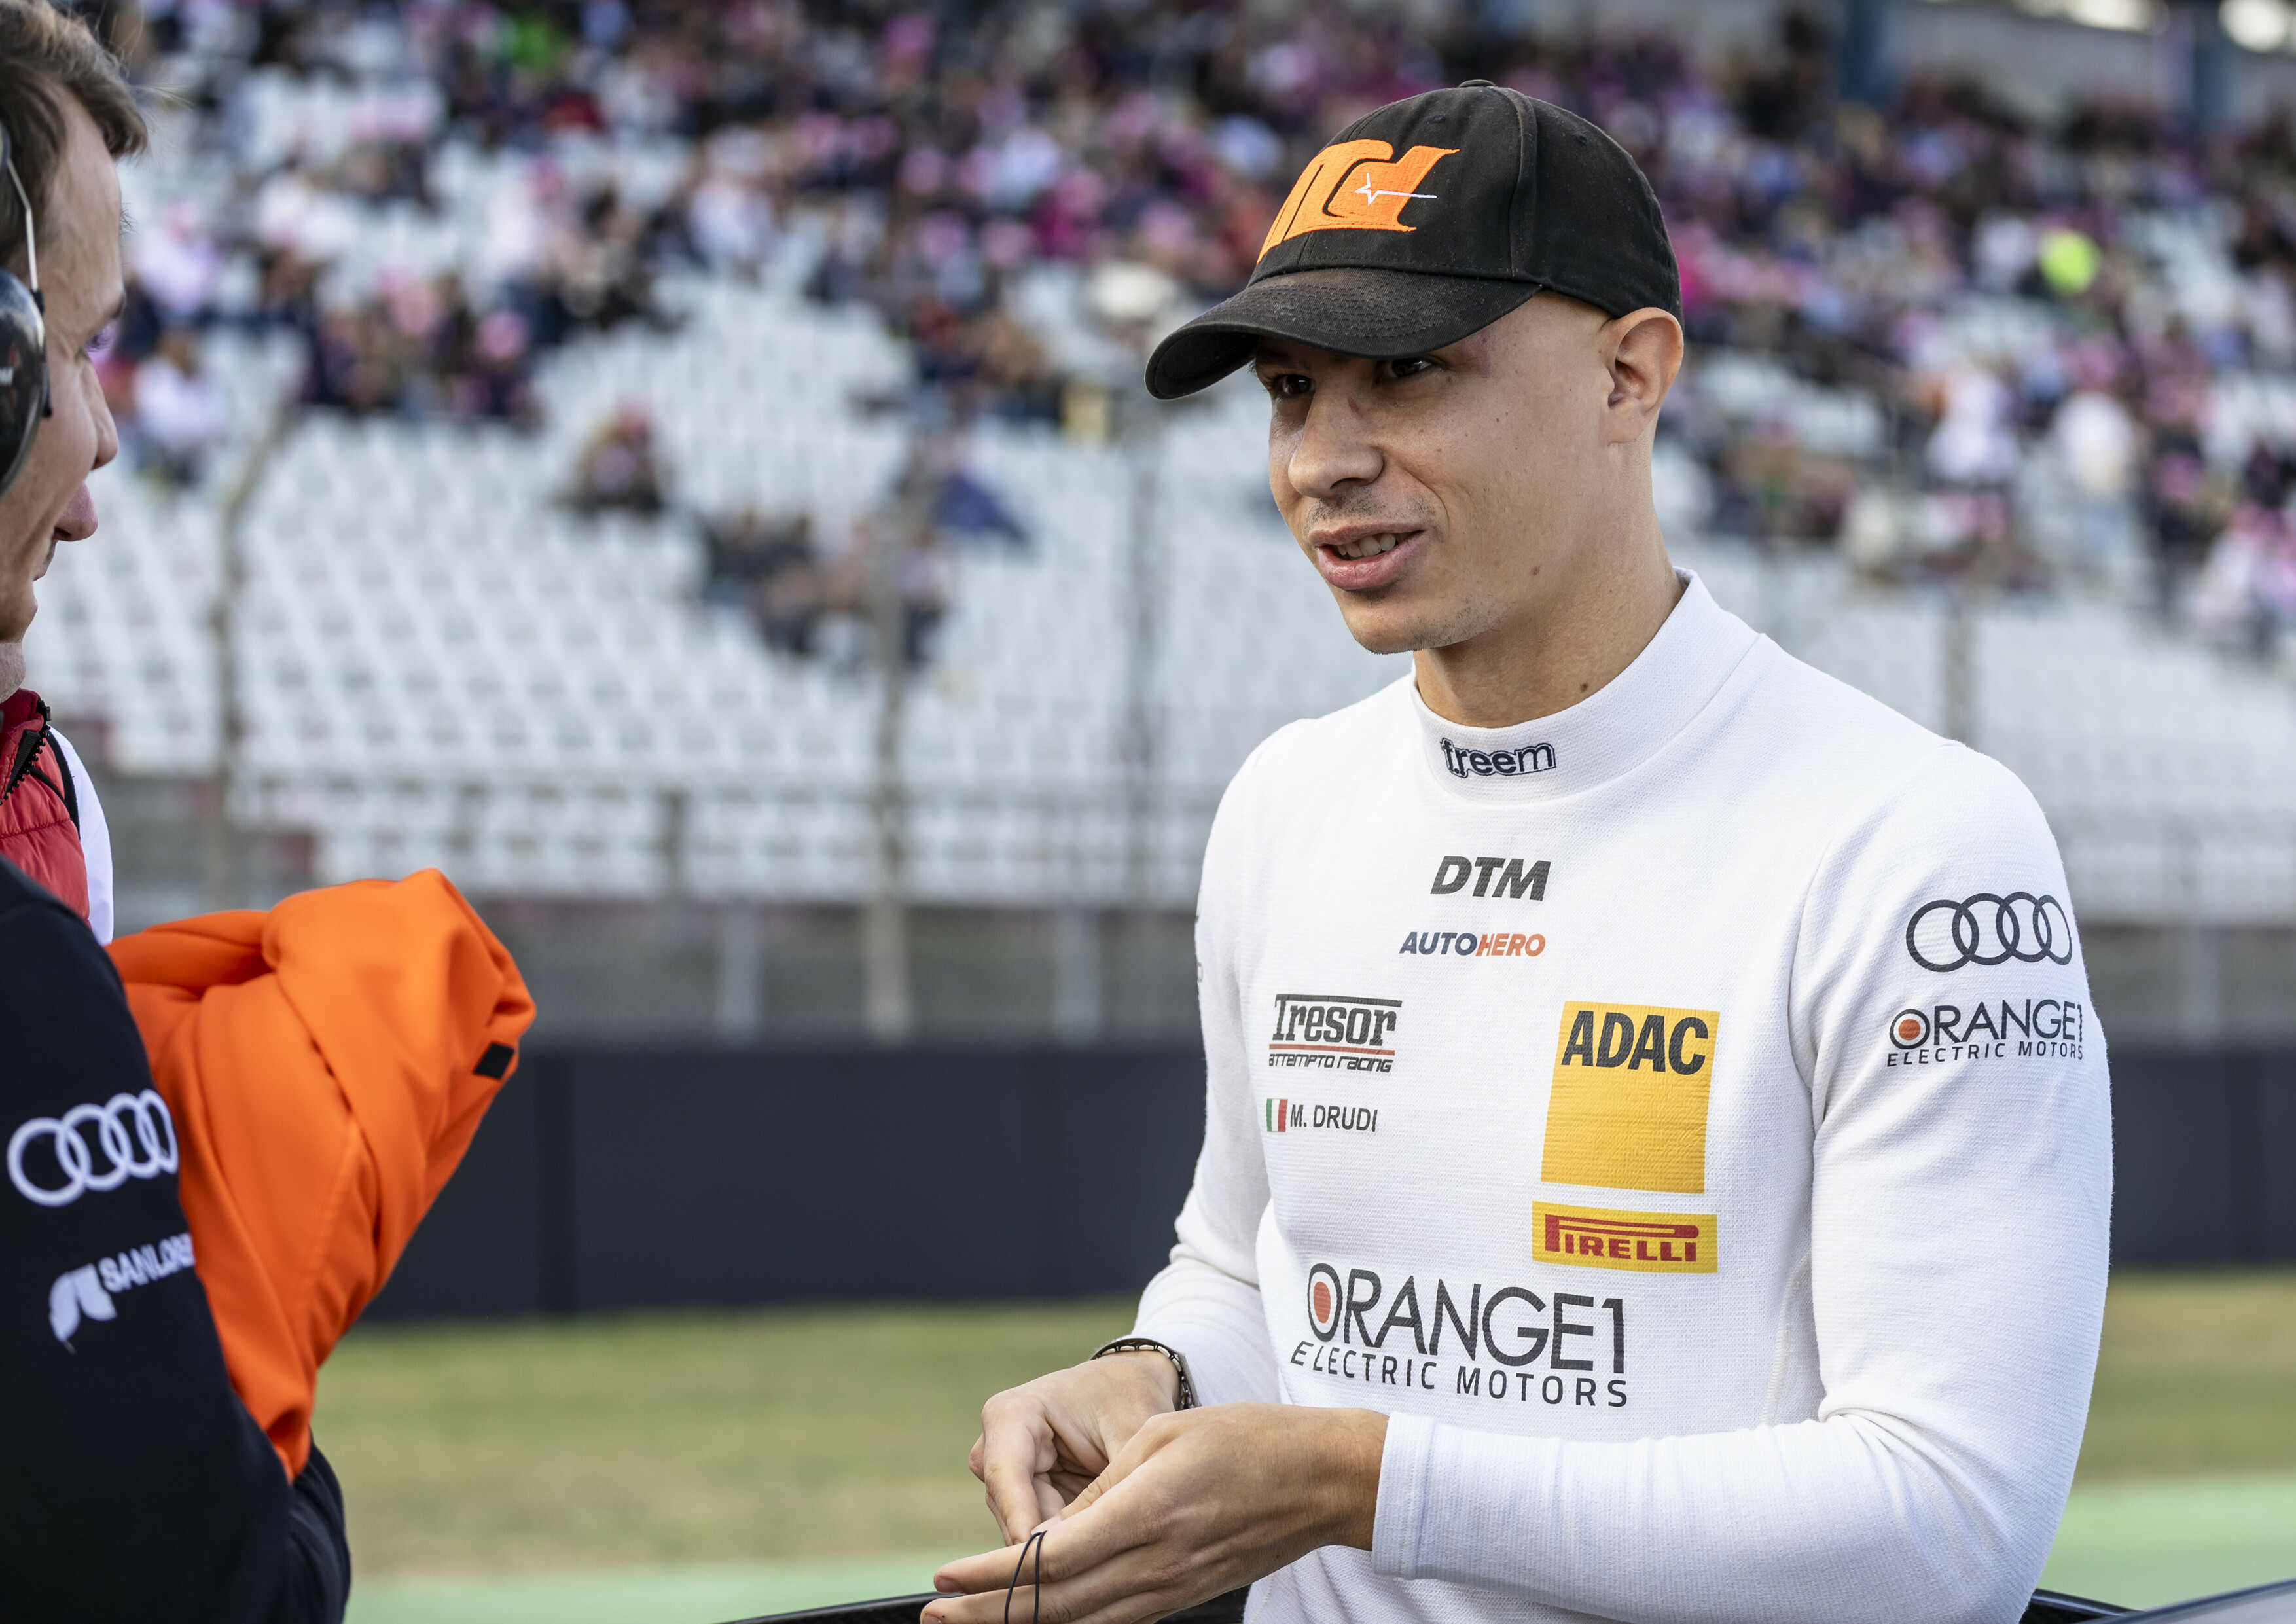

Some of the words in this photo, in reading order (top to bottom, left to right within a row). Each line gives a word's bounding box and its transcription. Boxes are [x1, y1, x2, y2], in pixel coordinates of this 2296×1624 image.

[1430, 855, 1551, 901] DTM
[1399, 931, 1546, 957] AUTOHERO
[1272, 994, 1403, 1047] Tresor
[1561, 1010, 1709, 1075] ADAC
[1889, 998, 2083, 1050] ORANGE1
[1887, 1043, 2006, 1067] ELECTRIC
[2018, 1041, 2083, 1060] MOTORS
[1290, 1104, 1308, 1128] M.
[1313, 1104, 1378, 1132] DRUDI
[1545, 1214, 1700, 1262] PIRELLI
[1307, 1263, 1625, 1374] ORANGE1
[1290, 1340, 1437, 1390] ELECTRIC
[1456, 1365, 1628, 1408] MOTORS
